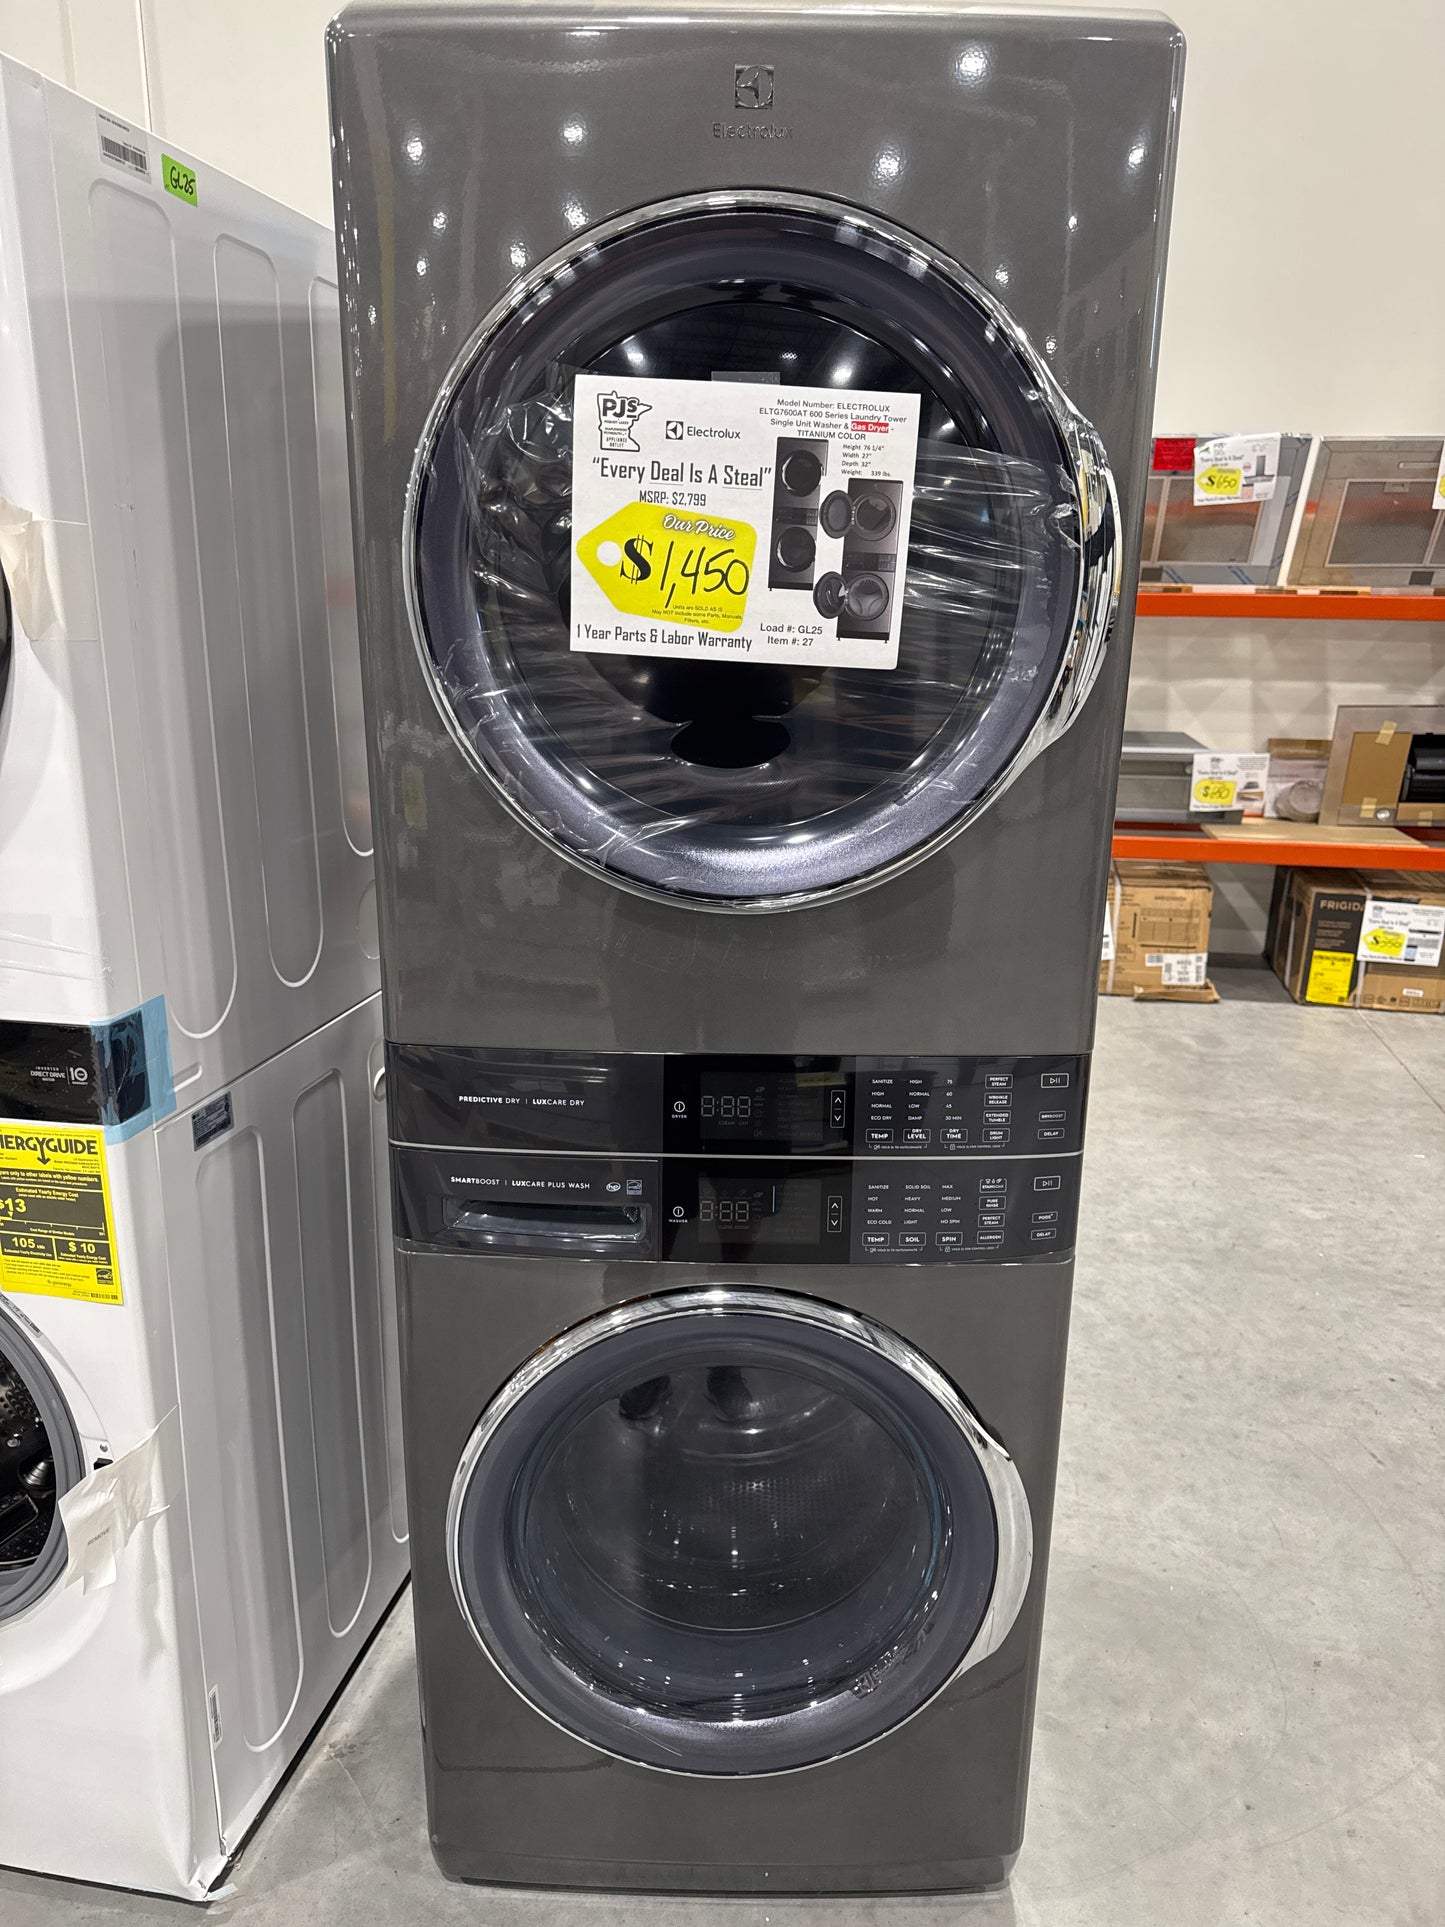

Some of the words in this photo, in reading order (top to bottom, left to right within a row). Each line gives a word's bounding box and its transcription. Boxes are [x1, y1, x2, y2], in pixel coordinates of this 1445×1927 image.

[713, 122, 792, 138] Electrolux
[170, 166, 196, 195] GL25
[777, 398, 800, 407] Model
[802, 400, 835, 410] Number:
[837, 403, 890, 412] ELECTROLUX
[809, 410, 823, 418] 600
[825, 411, 848, 420] Series
[850, 413, 881, 423] Laundry
[883, 415, 907, 423] Tower
[687, 426, 741, 440] Electrolux
[770, 419, 794, 428] Single
[813, 421, 842, 430] Washer
[851, 422, 866, 431] Gas
[868, 424, 889, 433] Dryer
[797, 430, 835, 439] TITANIUM
[838, 432, 866, 440] COLOR
[651, 460, 684, 482] Deal
[690, 462, 703, 482] Is
[708, 464, 718, 484] A
[639, 490, 669, 504] MSRP:
[672, 492, 706, 507] $2,799
[664, 514, 693, 532] Our
[695, 519, 736, 541] Price
[760, 623, 784, 633] Load
[798, 626, 823, 634] GL25
[577, 624, 581, 638] 1
[584, 624, 611, 640] Year
[615, 626, 646, 642] Parts
[650, 628, 657, 643] &
[662, 628, 694, 646] Labor
[698, 631, 752, 652] Warranty
[768, 636, 788, 645] Item
[70, 1067, 88, 1081] 10
[451, 1176, 500, 1185] SMARTBOOST
[12, 1237, 35, 1248] 105
[81, 1243, 95, 1253] 10
[87, 1527, 110, 1545] REMOVE
